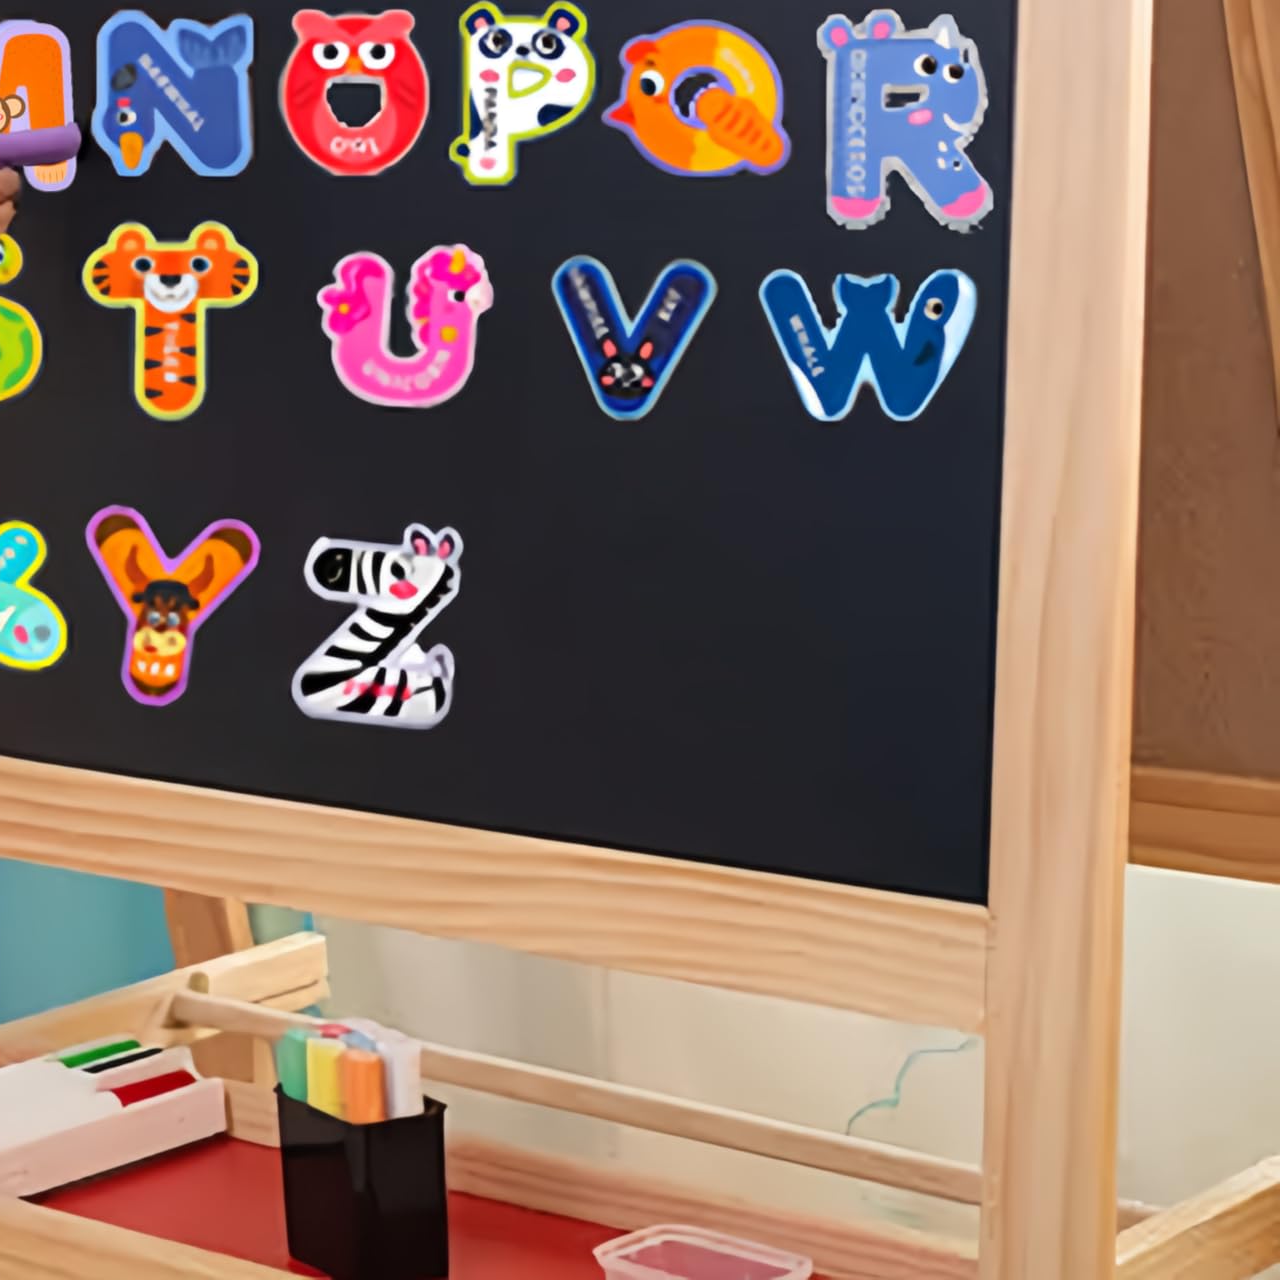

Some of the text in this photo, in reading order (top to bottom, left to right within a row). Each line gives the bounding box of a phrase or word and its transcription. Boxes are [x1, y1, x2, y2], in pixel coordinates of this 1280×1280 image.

[91, 10, 254, 177] N
[279, 9, 430, 176] O
[449, 0, 596, 185] P
[602, 19, 791, 177] Q
[816, 9, 994, 233] R
[82, 221, 258, 420] T
[317, 243, 494, 408] U
[551, 255, 717, 420] V
[759, 269, 977, 421] W
[85, 505, 261, 706] Y
[292, 523, 464, 729] Z
